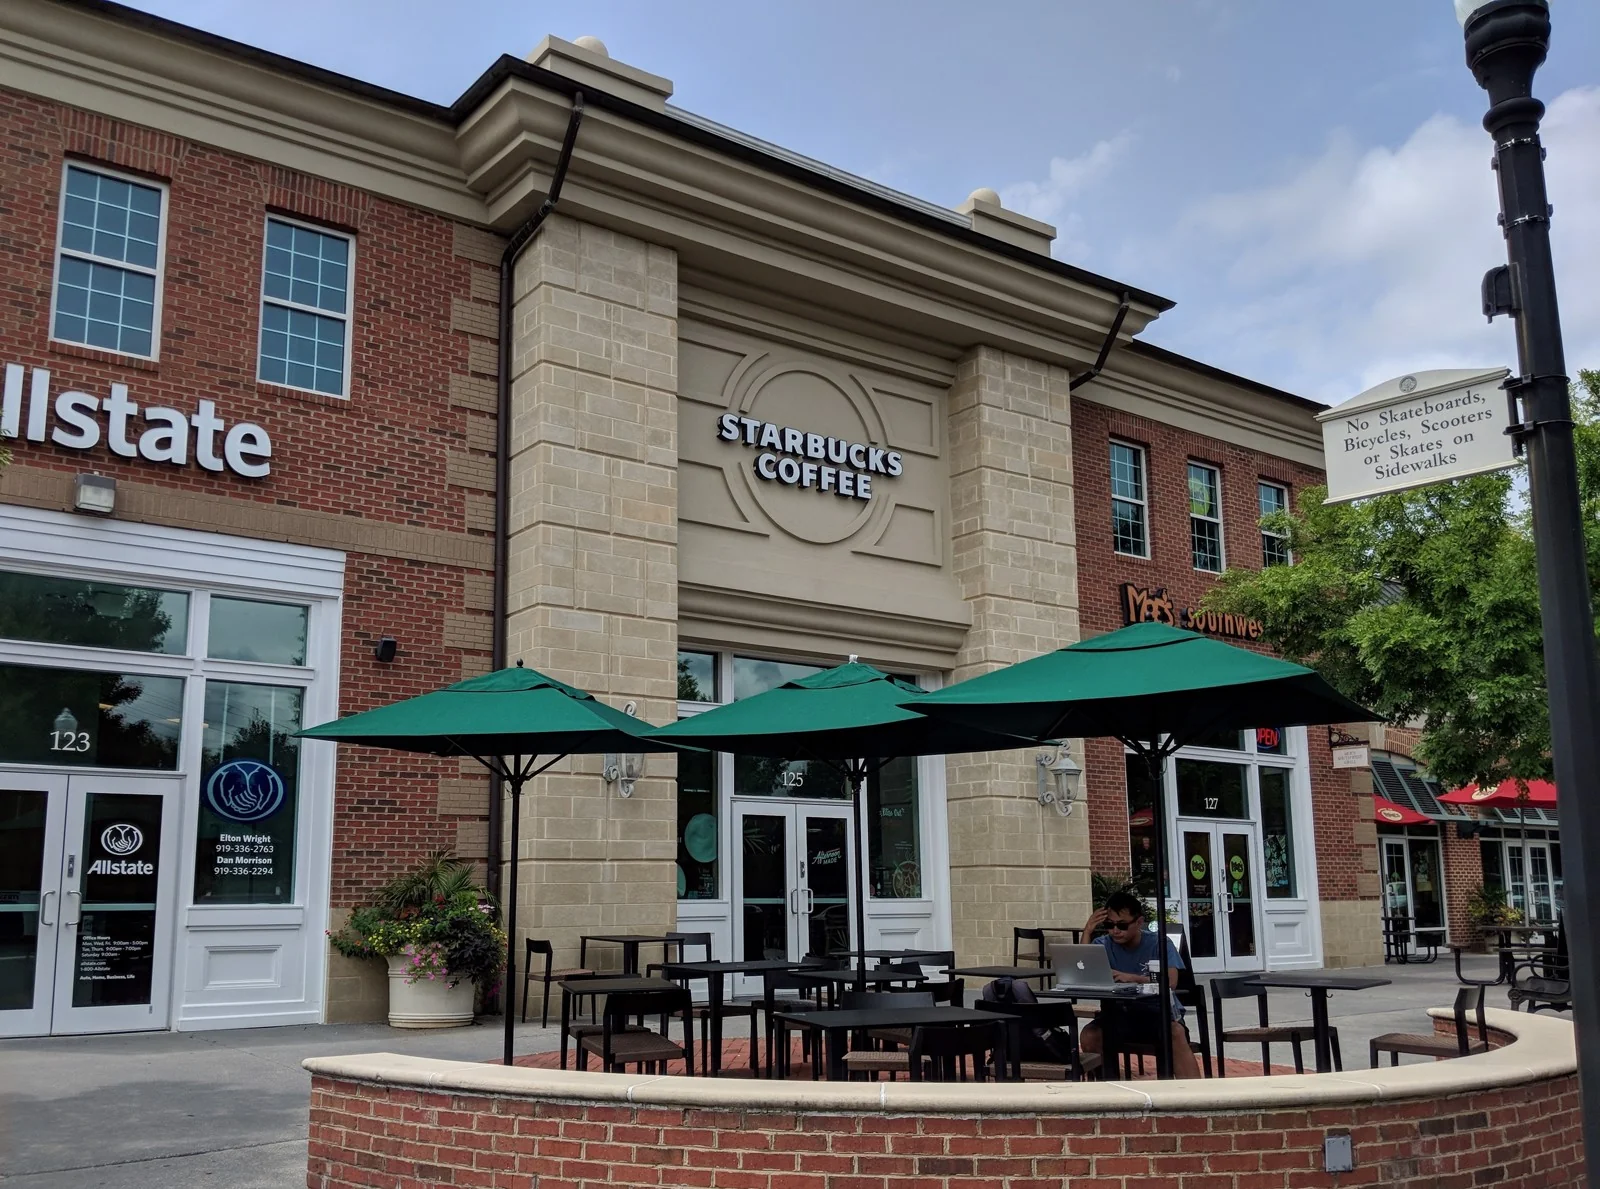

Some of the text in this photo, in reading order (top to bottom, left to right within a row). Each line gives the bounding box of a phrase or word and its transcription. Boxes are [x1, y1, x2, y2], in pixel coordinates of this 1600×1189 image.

[0, 363, 272, 478] llstate
[1346, 390, 1486, 434] No Skateboards,
[1344, 409, 1493, 452] Bicycles, Scooters
[718, 413, 903, 477] STARBUCKS
[1364, 432, 1474, 465] or Skates on
[755, 453, 872, 500] COFFEE
[1375, 452, 1457, 480] Sidewalks
[50, 731, 91, 752] 123
[781, 771, 804, 787] 125
[1203, 797, 1219, 810] 127
[215, 844, 274, 853] 919-336-2763
[220, 834, 271, 844] Elton Wright
[87, 860, 154, 875] Allstate
[216, 856, 272, 864] Dan Morrison
[214, 867, 274, 875] 919-336-2294
